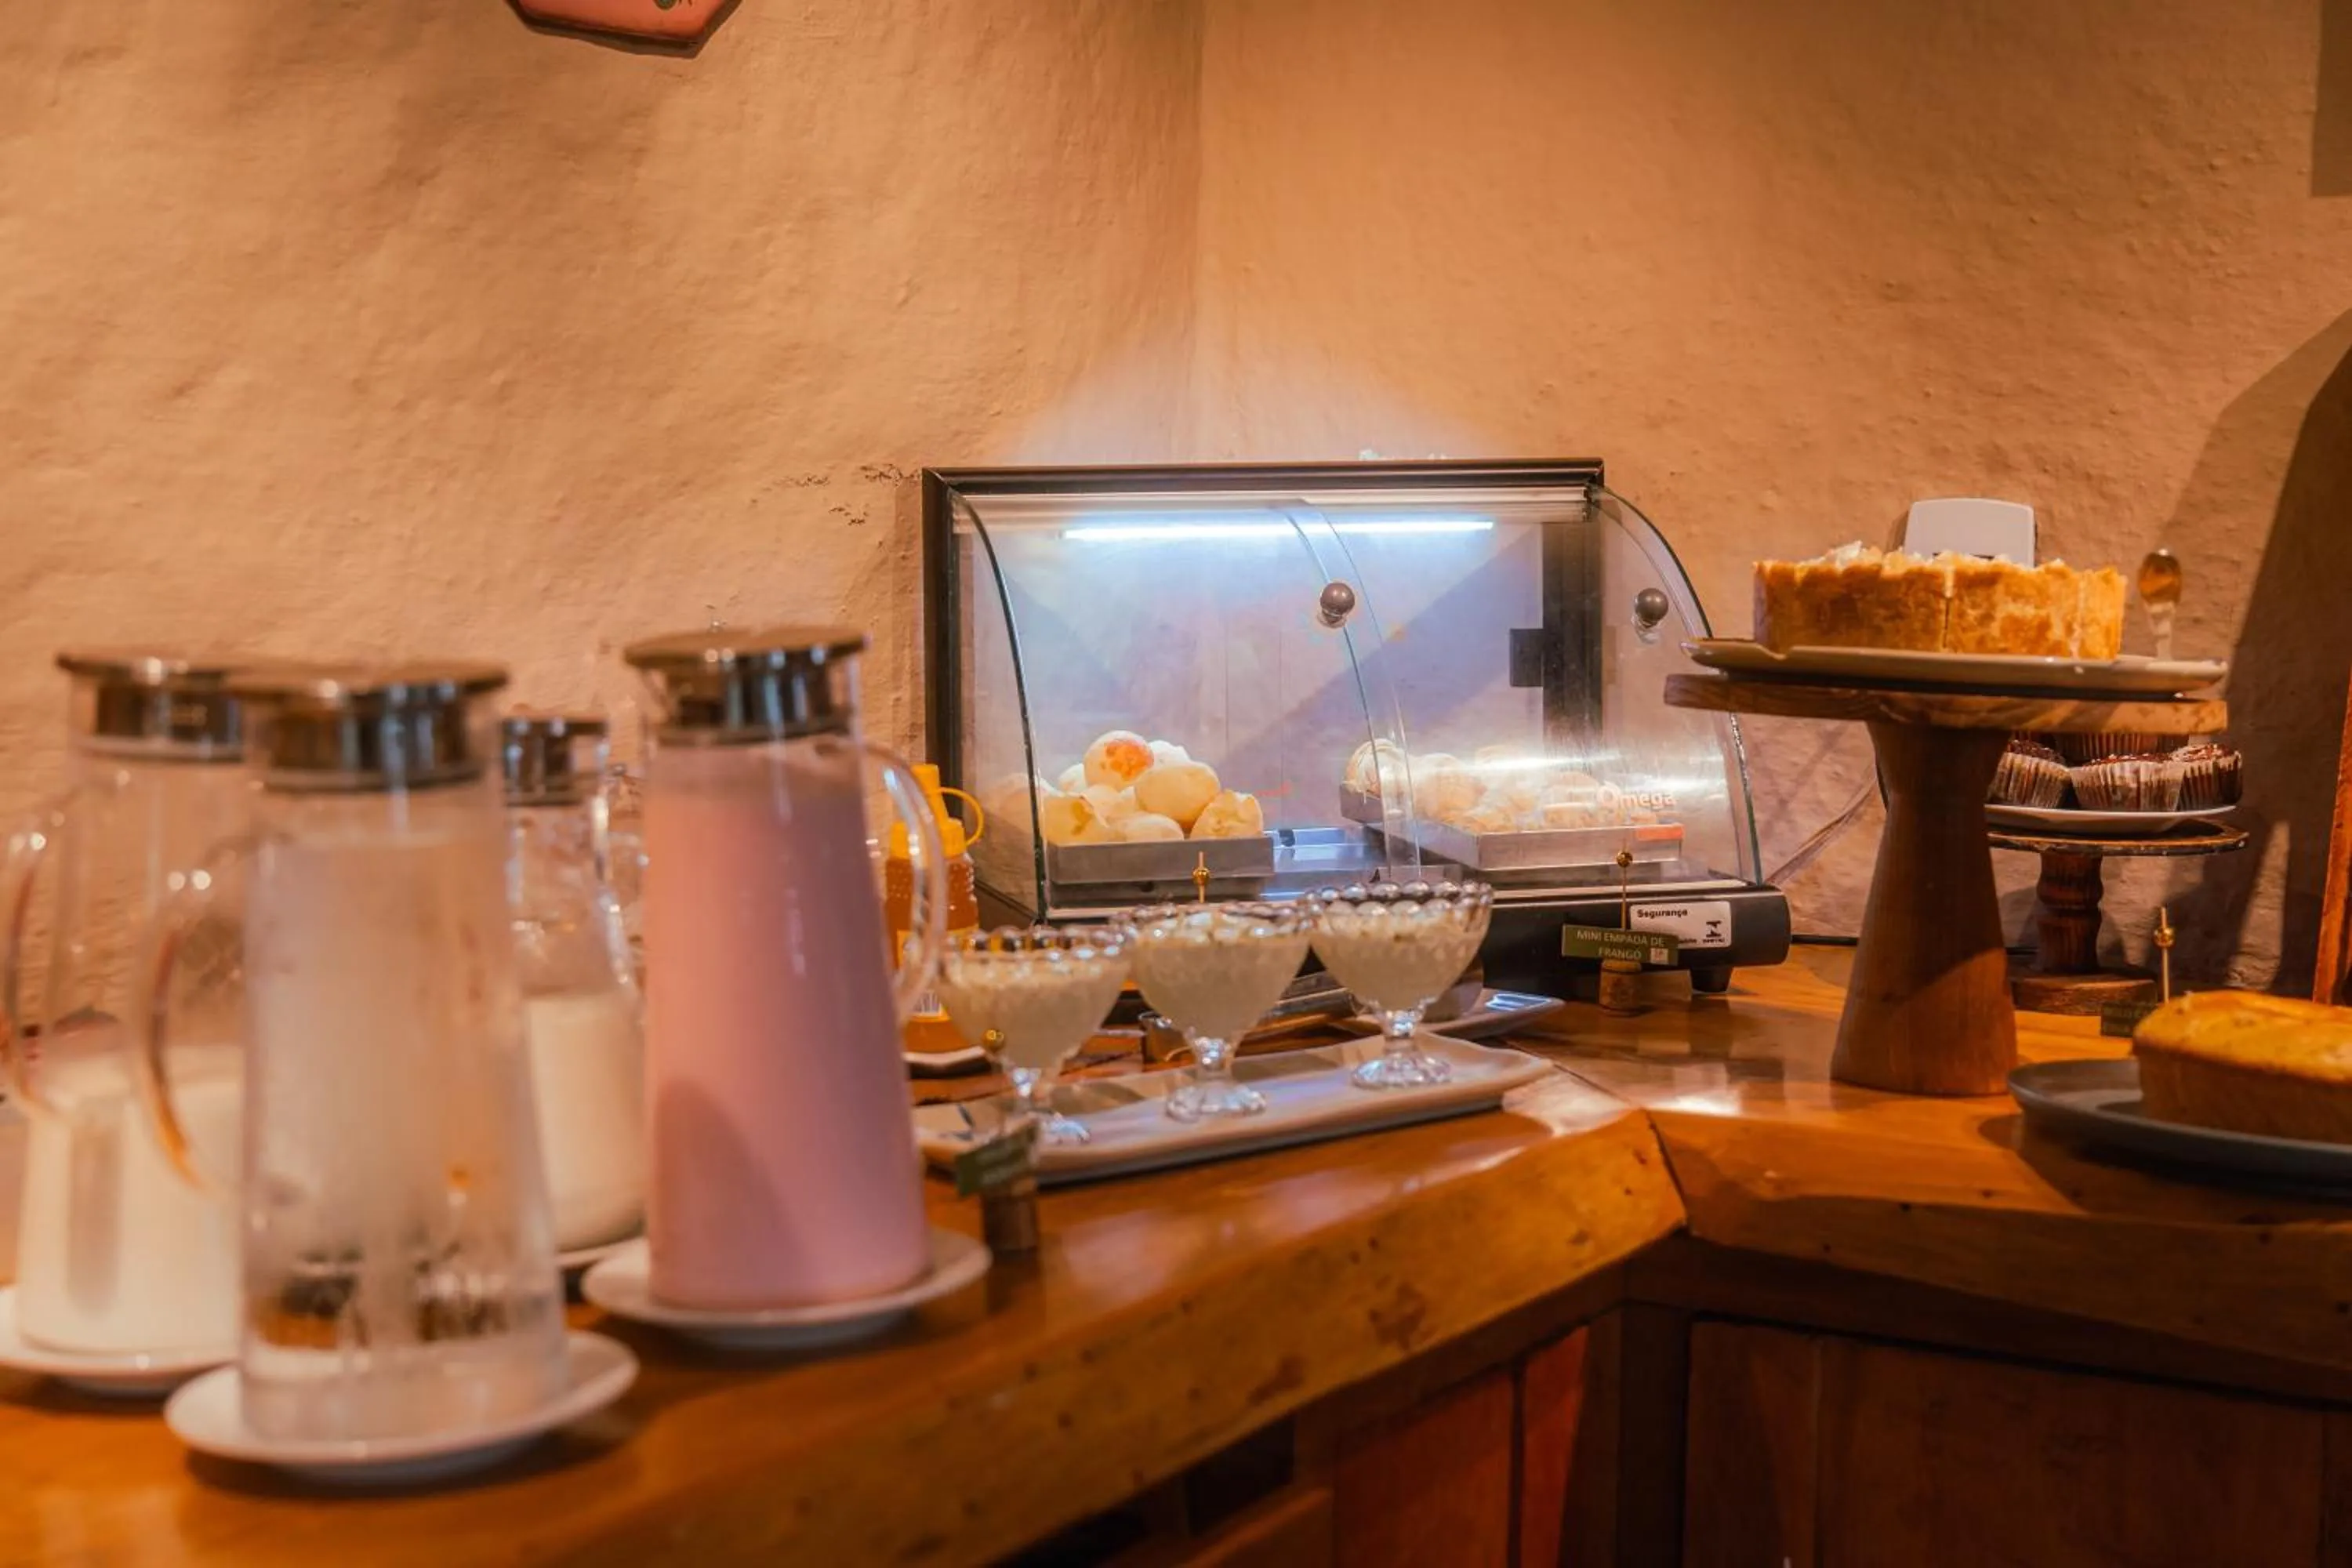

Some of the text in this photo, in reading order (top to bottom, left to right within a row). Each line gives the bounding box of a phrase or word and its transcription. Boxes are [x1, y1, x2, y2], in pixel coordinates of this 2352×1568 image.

[1597, 781, 1676, 809] Omega
[1576, 930, 1665, 948] MINI EMPADA DE
